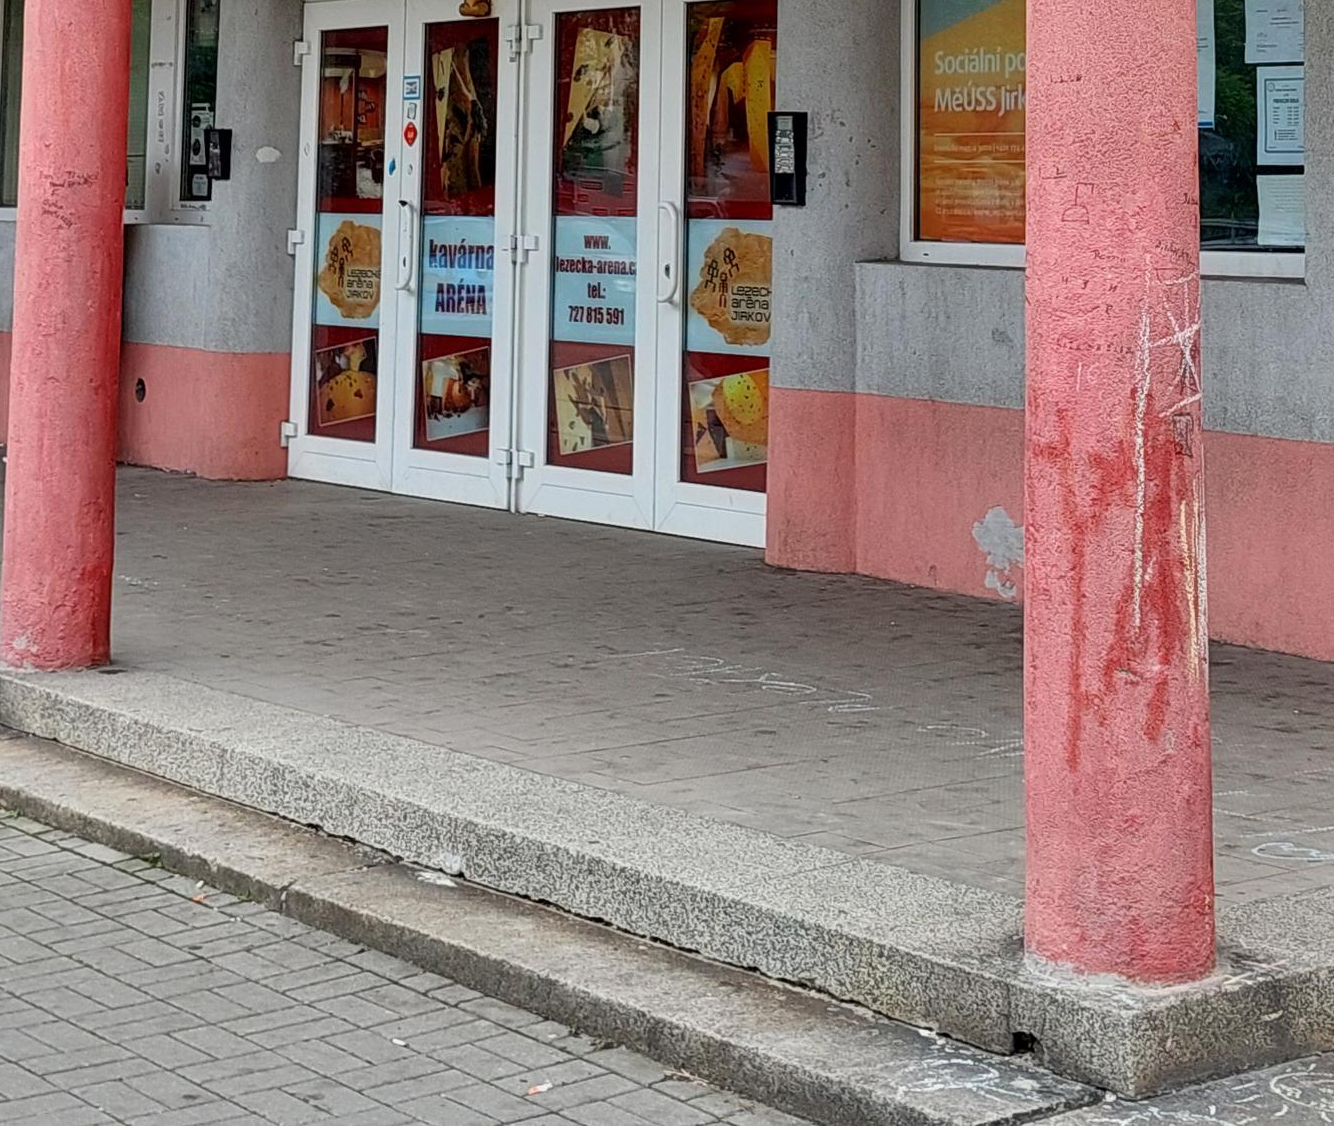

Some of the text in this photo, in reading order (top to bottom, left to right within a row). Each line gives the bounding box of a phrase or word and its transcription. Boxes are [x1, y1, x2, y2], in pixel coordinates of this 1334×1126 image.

[934, 46, 1002, 75] Sociální
[933, 79, 997, 113] MěÚSS
[429, 238, 494, 270] kavárna
[583, 235, 612, 250] www.
[555, 256, 637, 275] lezecka-arena.c
[435, 278, 488, 315] ARÉNA
[568, 305, 625, 325] 727 815 591
[731, 311, 772, 323] JIRKOV
